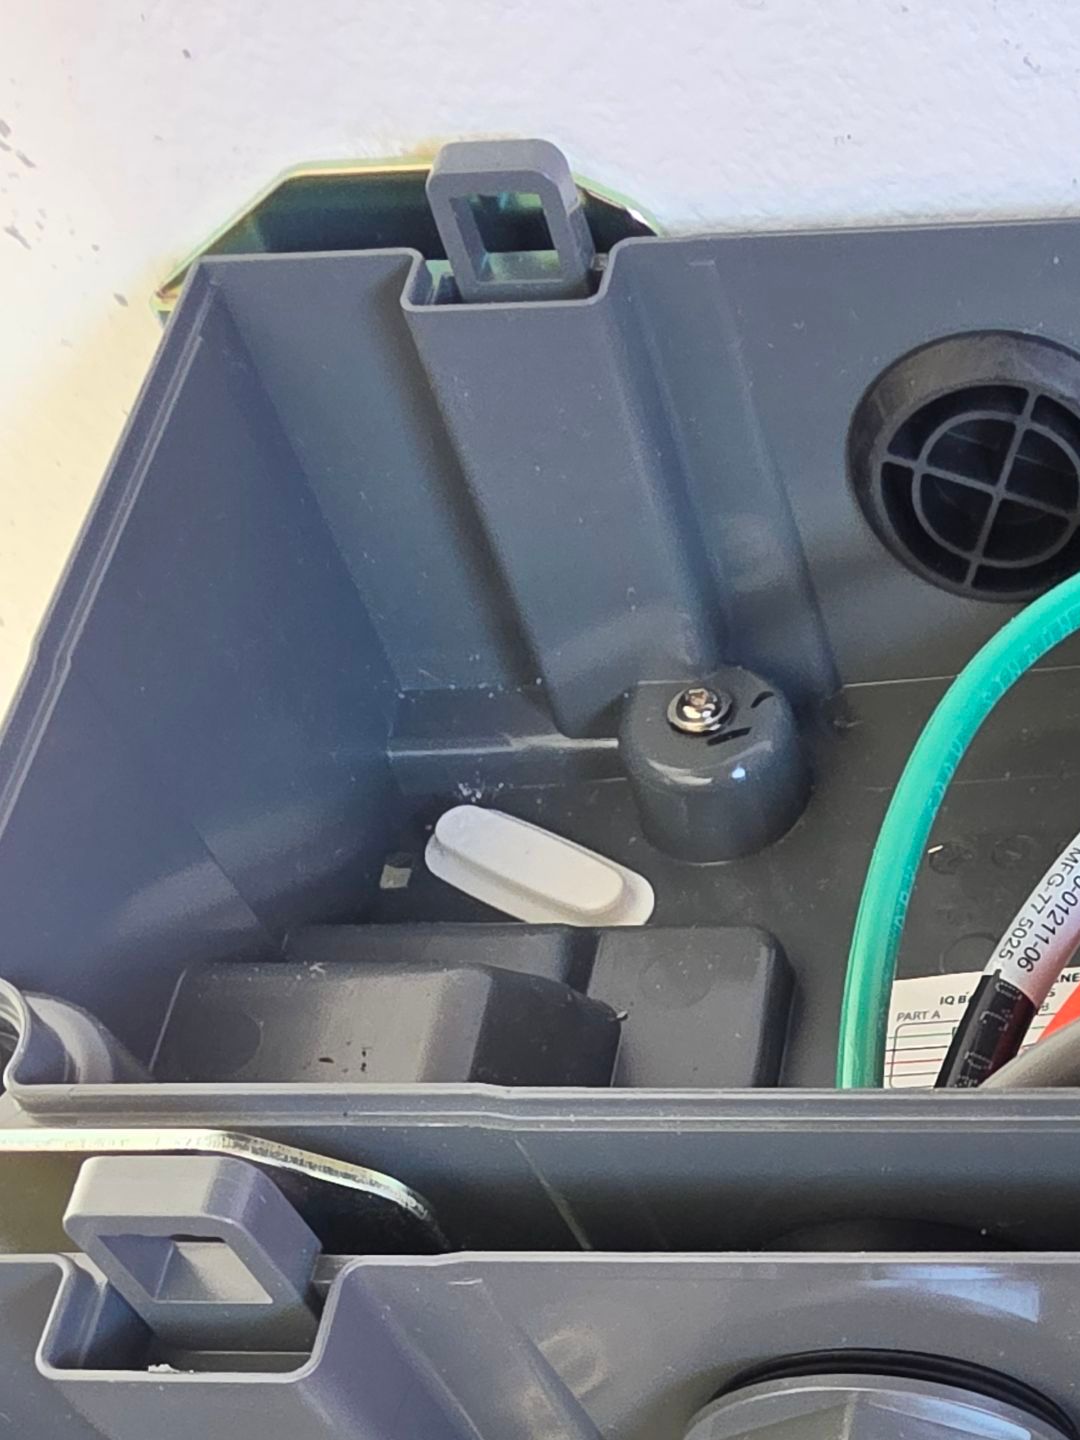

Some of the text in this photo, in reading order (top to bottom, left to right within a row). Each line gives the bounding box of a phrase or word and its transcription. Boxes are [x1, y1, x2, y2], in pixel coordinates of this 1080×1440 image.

[999, 917, 1034, 960] 5025
[897, 1009, 941, 1022] PART A
